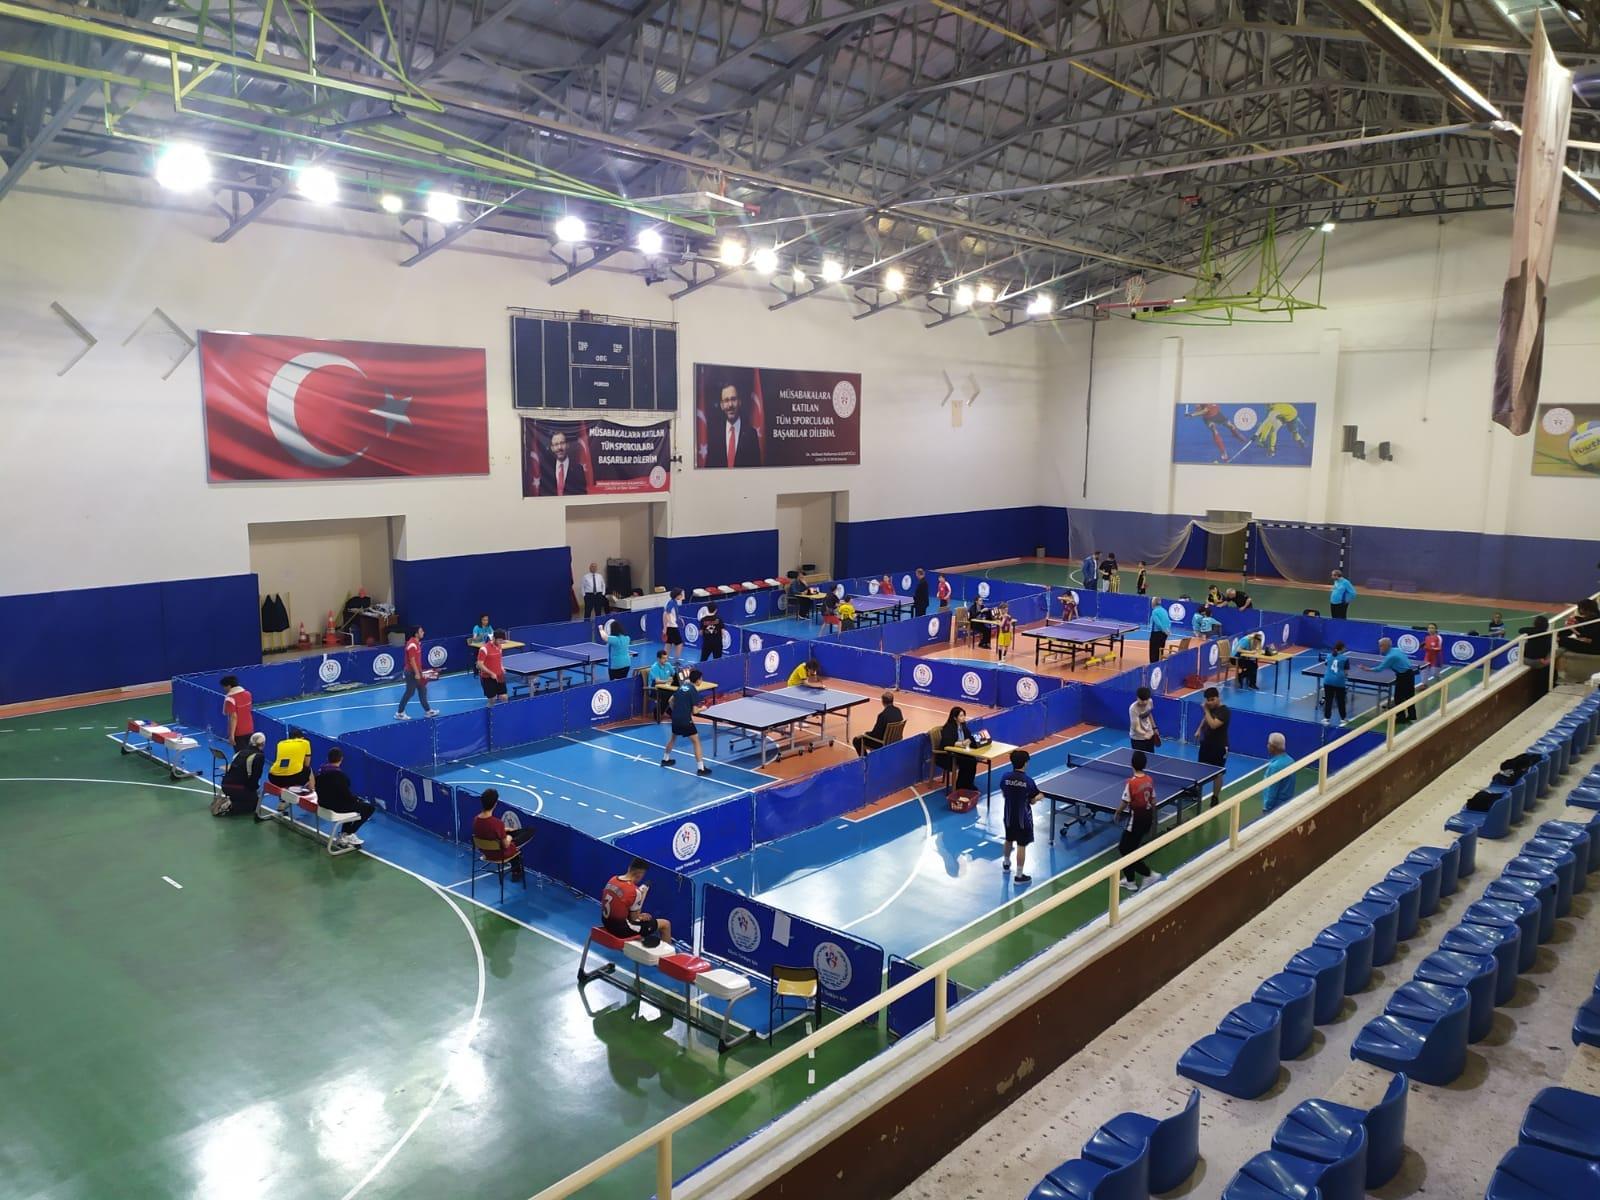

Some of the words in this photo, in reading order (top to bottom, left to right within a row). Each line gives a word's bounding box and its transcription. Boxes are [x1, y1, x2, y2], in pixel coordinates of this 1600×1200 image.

[779, 388, 832, 400] MÜSABAKALARA
[791, 403, 820, 412] KATILAN
[775, 414, 791, 425] TÜM
[792, 416, 834, 425] SPORCULARA
[589, 426, 641, 438] MÜSABAKALARA
[641, 429, 665, 438] KATILAN
[772, 428, 808, 440] BAŞARILAR
[601, 440, 615, 451] TÜM
[598, 455, 633, 465] BAŞARILAR
[602, 893, 613, 919] 3
